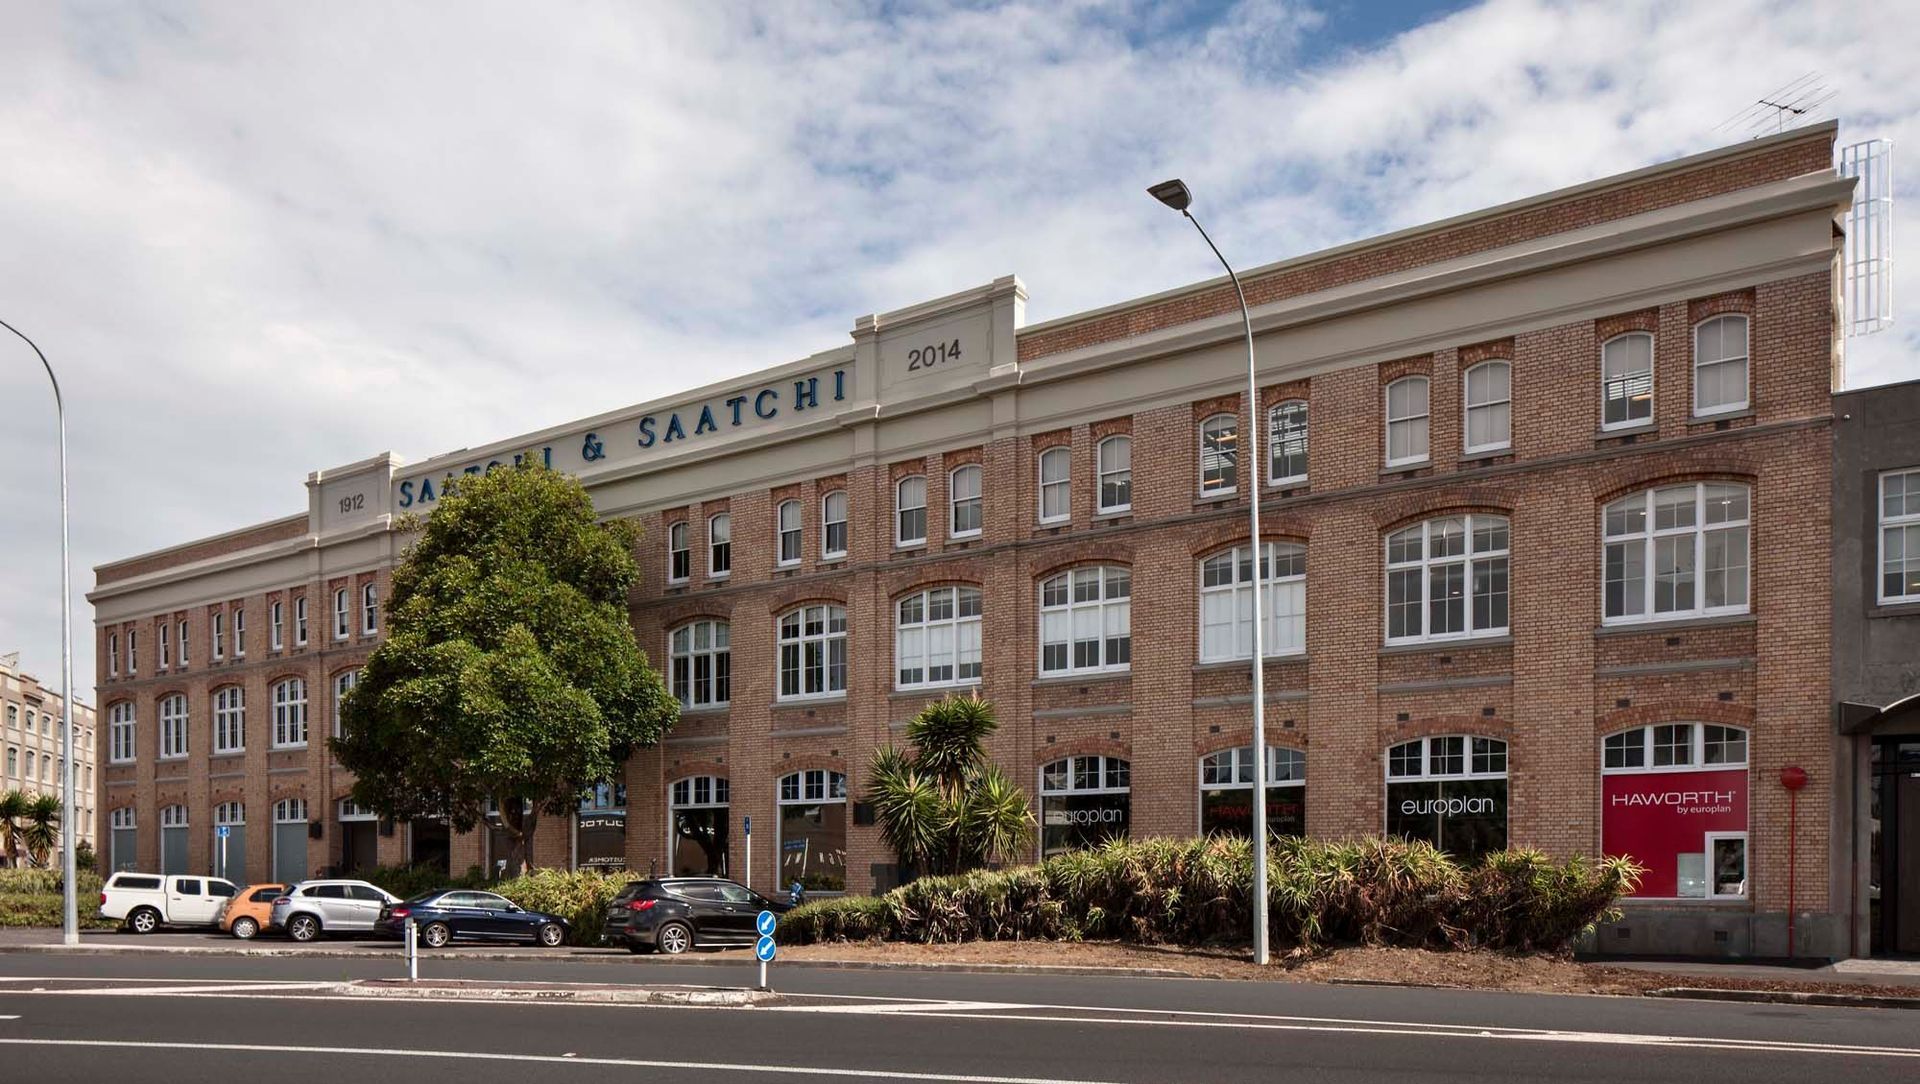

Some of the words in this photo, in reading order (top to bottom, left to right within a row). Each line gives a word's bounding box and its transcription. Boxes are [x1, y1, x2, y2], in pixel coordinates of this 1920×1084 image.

[908, 339, 961, 371] 2014
[399, 447, 552, 508] SAAI
[582, 432, 606, 461] &
[638, 370, 846, 448] SAATCHI
[338, 493, 365, 514] 1912
[1210, 803, 1299, 817] HAWTH
[1401, 795, 1493, 817] europlan
[1677, 805, 1688, 814] by
[1690, 804, 1731, 814] europlan
